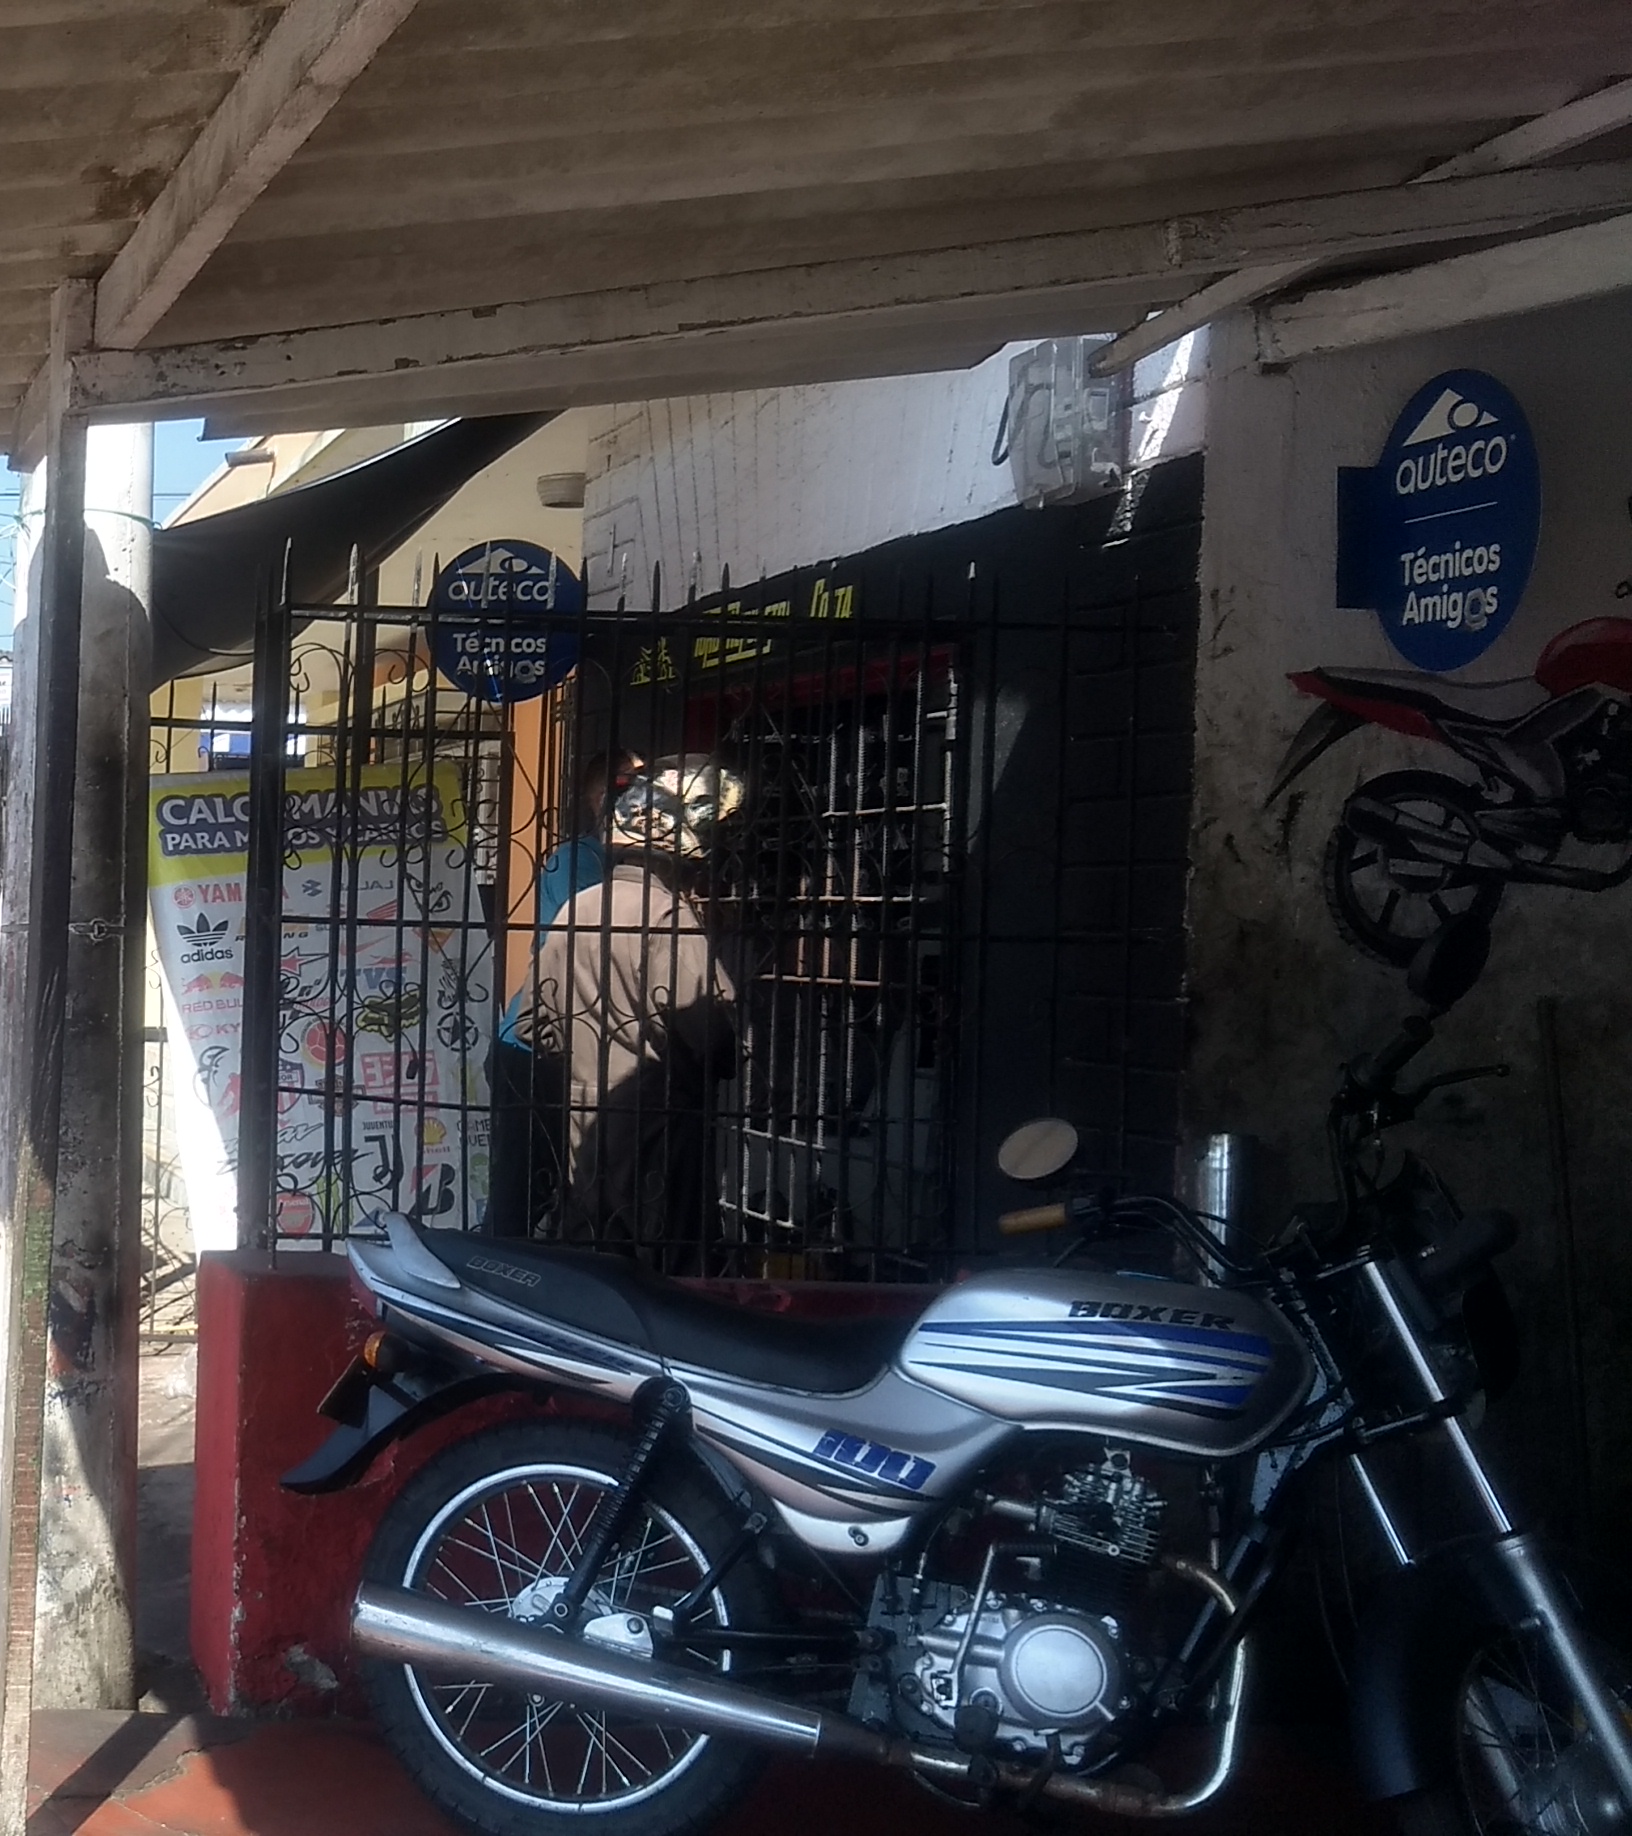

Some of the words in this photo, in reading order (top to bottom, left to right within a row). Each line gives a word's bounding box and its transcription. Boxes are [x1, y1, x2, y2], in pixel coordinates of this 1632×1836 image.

[1396, 436, 1507, 494] auteco
[1400, 541, 1501, 586] Técnicos
[453, 630, 546, 652] Técncos
[161, 786, 438, 825] CALCMANIAS
[166, 832, 231, 851] PARA
[235, 826, 319, 847] MOS
[180, 947, 234, 964] adidas
[182, 1001, 213, 1014] RED
[362, 1119, 398, 1131] JUVENTU
[467, 1255, 542, 1288] BOXER
[1068, 1300, 1235, 1332] BOXER
[812, 1428, 937, 1490] 100
